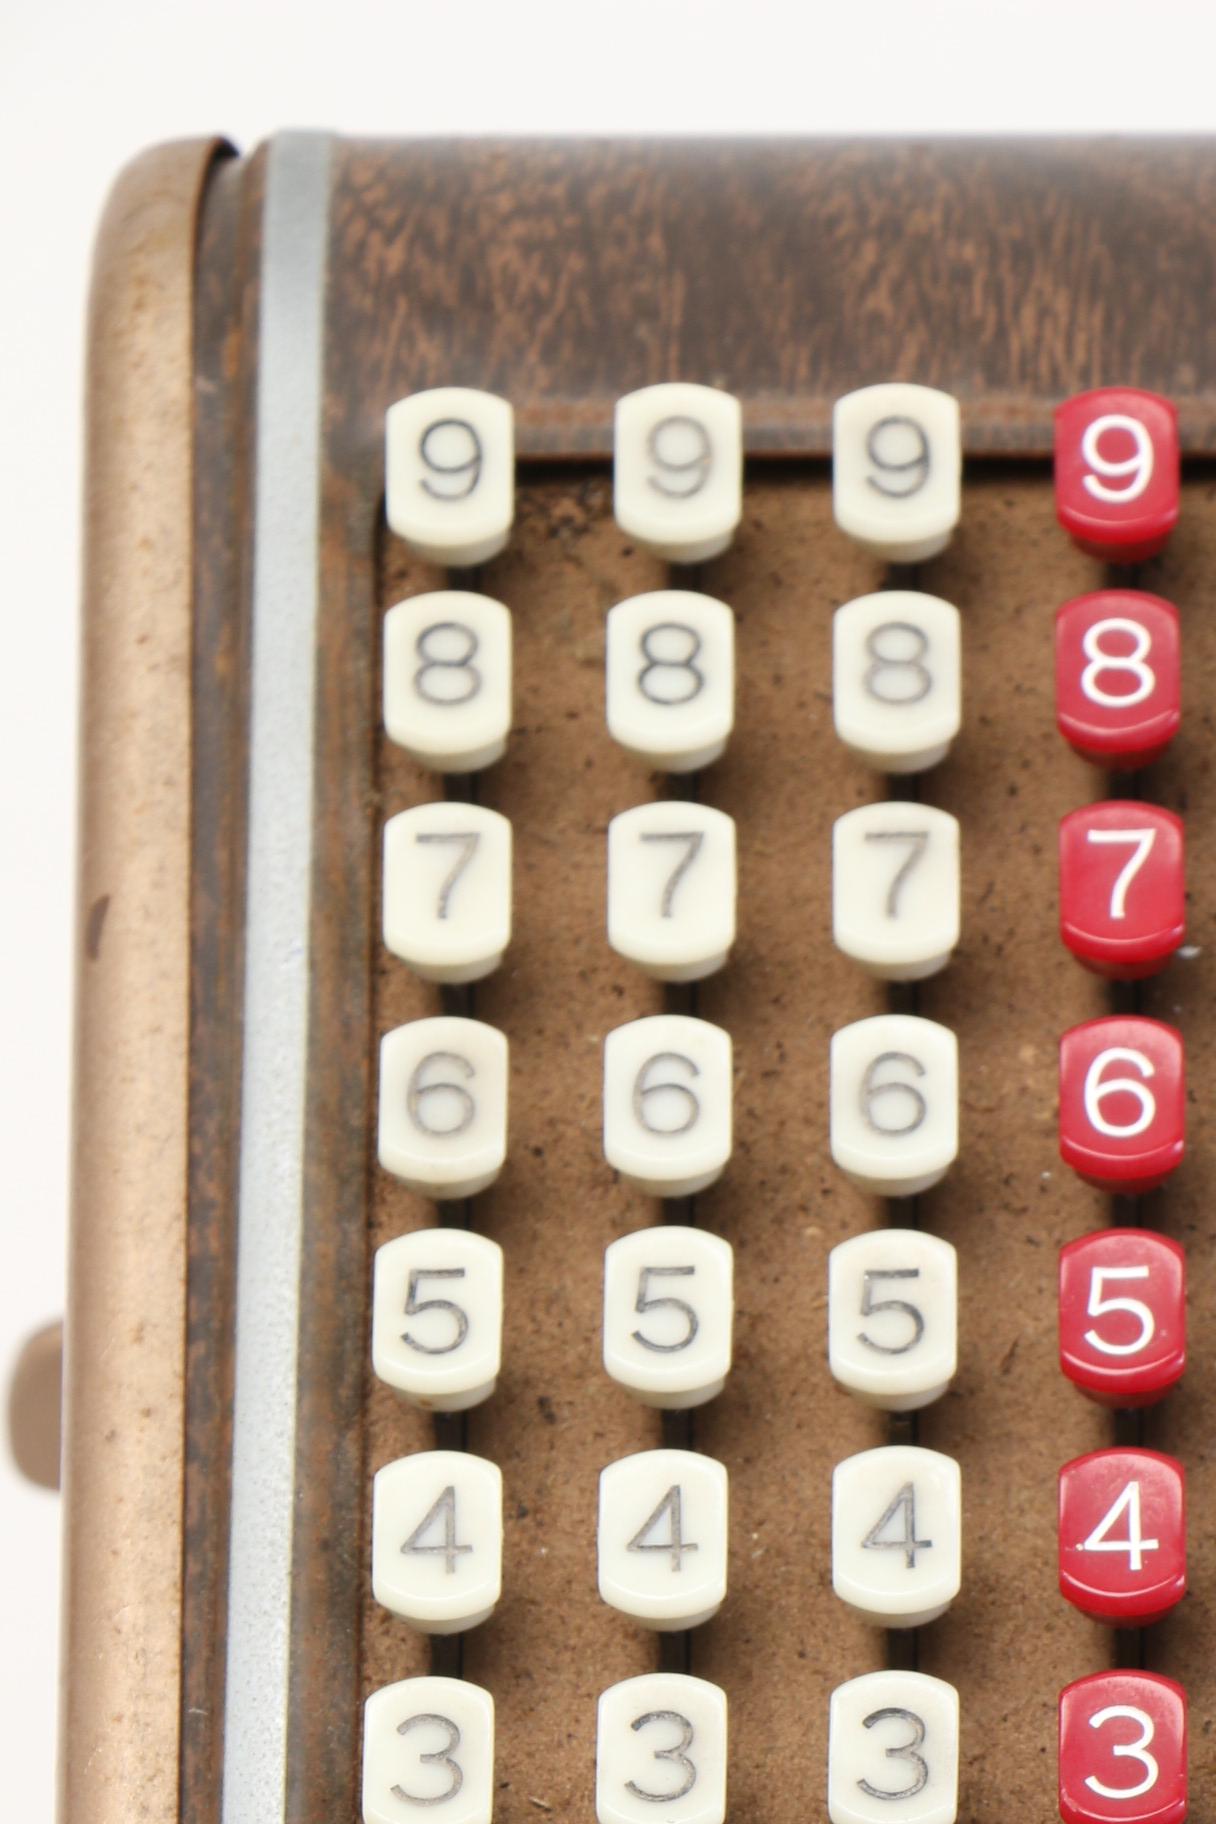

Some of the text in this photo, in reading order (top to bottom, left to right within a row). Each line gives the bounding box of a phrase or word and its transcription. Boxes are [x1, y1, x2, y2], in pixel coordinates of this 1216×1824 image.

[417, 417, 485, 502] 9
[644, 414, 715, 501] 9
[864, 415, 932, 500] 9
[1081, 414, 1154, 504] 9
[412, 620, 483, 708] 8
[635, 621, 707, 708] 8
[862, 620, 935, 708] 8
[1081, 618, 1156, 708] 8
[414, 831, 482, 921] 7
[639, 831, 705, 919] 7
[863, 830, 930, 920] 7
[1087, 828, 1156, 920] 7
[405, 1050, 478, 1141] 6
[632, 1051, 702, 1139] 6
[858, 1051, 928, 1139] 6
[1084, 1048, 1156, 1138] 6
[400, 1267, 470, 1356] 5
[631, 1265, 700, 1355] 5
[857, 1268, 926, 1356] 5
[1084, 1265, 1155, 1356] 5
[399, 1484, 474, 1575] 4
[625, 1484, 699, 1572] 4
[860, 1481, 933, 1570] 4
[1084, 1481, 1159, 1570] 4
[390, 1713, 464, 1808] 3
[624, 1709, 697, 1804] 3
[856, 1707, 930, 1802] 3
[1084, 1705, 1159, 1800] 3
